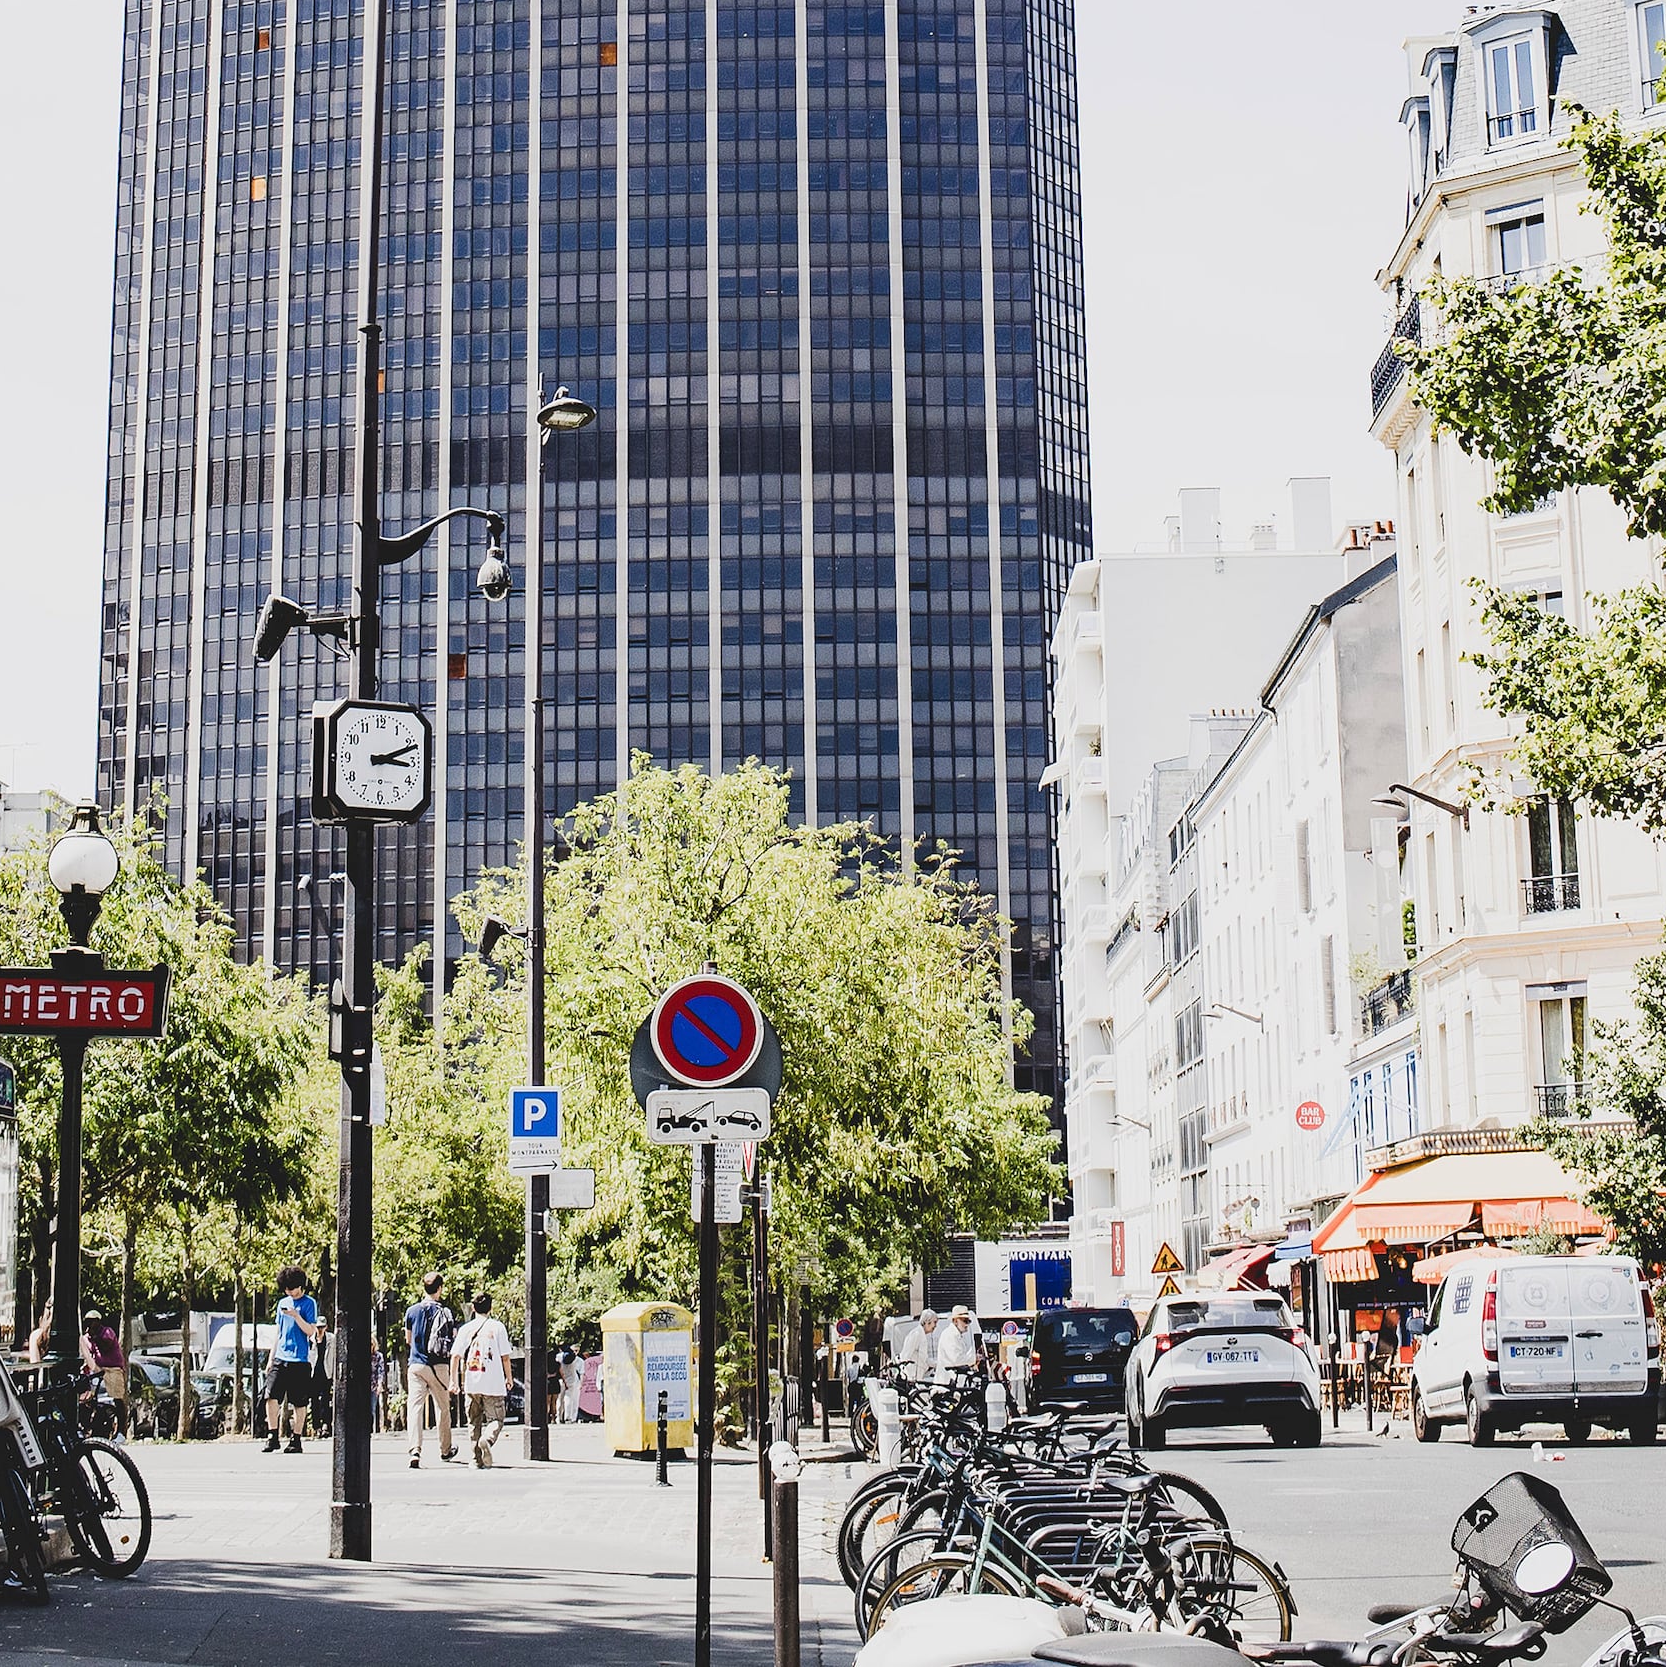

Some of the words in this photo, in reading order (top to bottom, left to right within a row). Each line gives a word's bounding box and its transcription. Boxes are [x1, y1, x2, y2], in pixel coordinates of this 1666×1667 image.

[361, 722, 369, 733] 11
[376, 718, 386, 729] 12
[395, 725, 399, 736] 1
[349, 734, 359, 745] 10
[405, 738, 412, 748] 2
[344, 752, 351, 763] 9
[409, 757, 416, 768] 3
[349, 771, 356, 782] 8
[405, 775, 412, 786] 4
[361, 784, 368, 795] 7
[393, 786, 400, 797] 5
[377, 790, 384, 802] 6
[3, 984, 145, 1021] METRO
[523, 1098, 547, 1131] P
[1301, 1107, 1320, 1116] BAR
[1298, 1117, 1322, 1125] CLUB
[647, 1372, 661, 1381] PAR
[661, 1372, 670, 1381] LA
